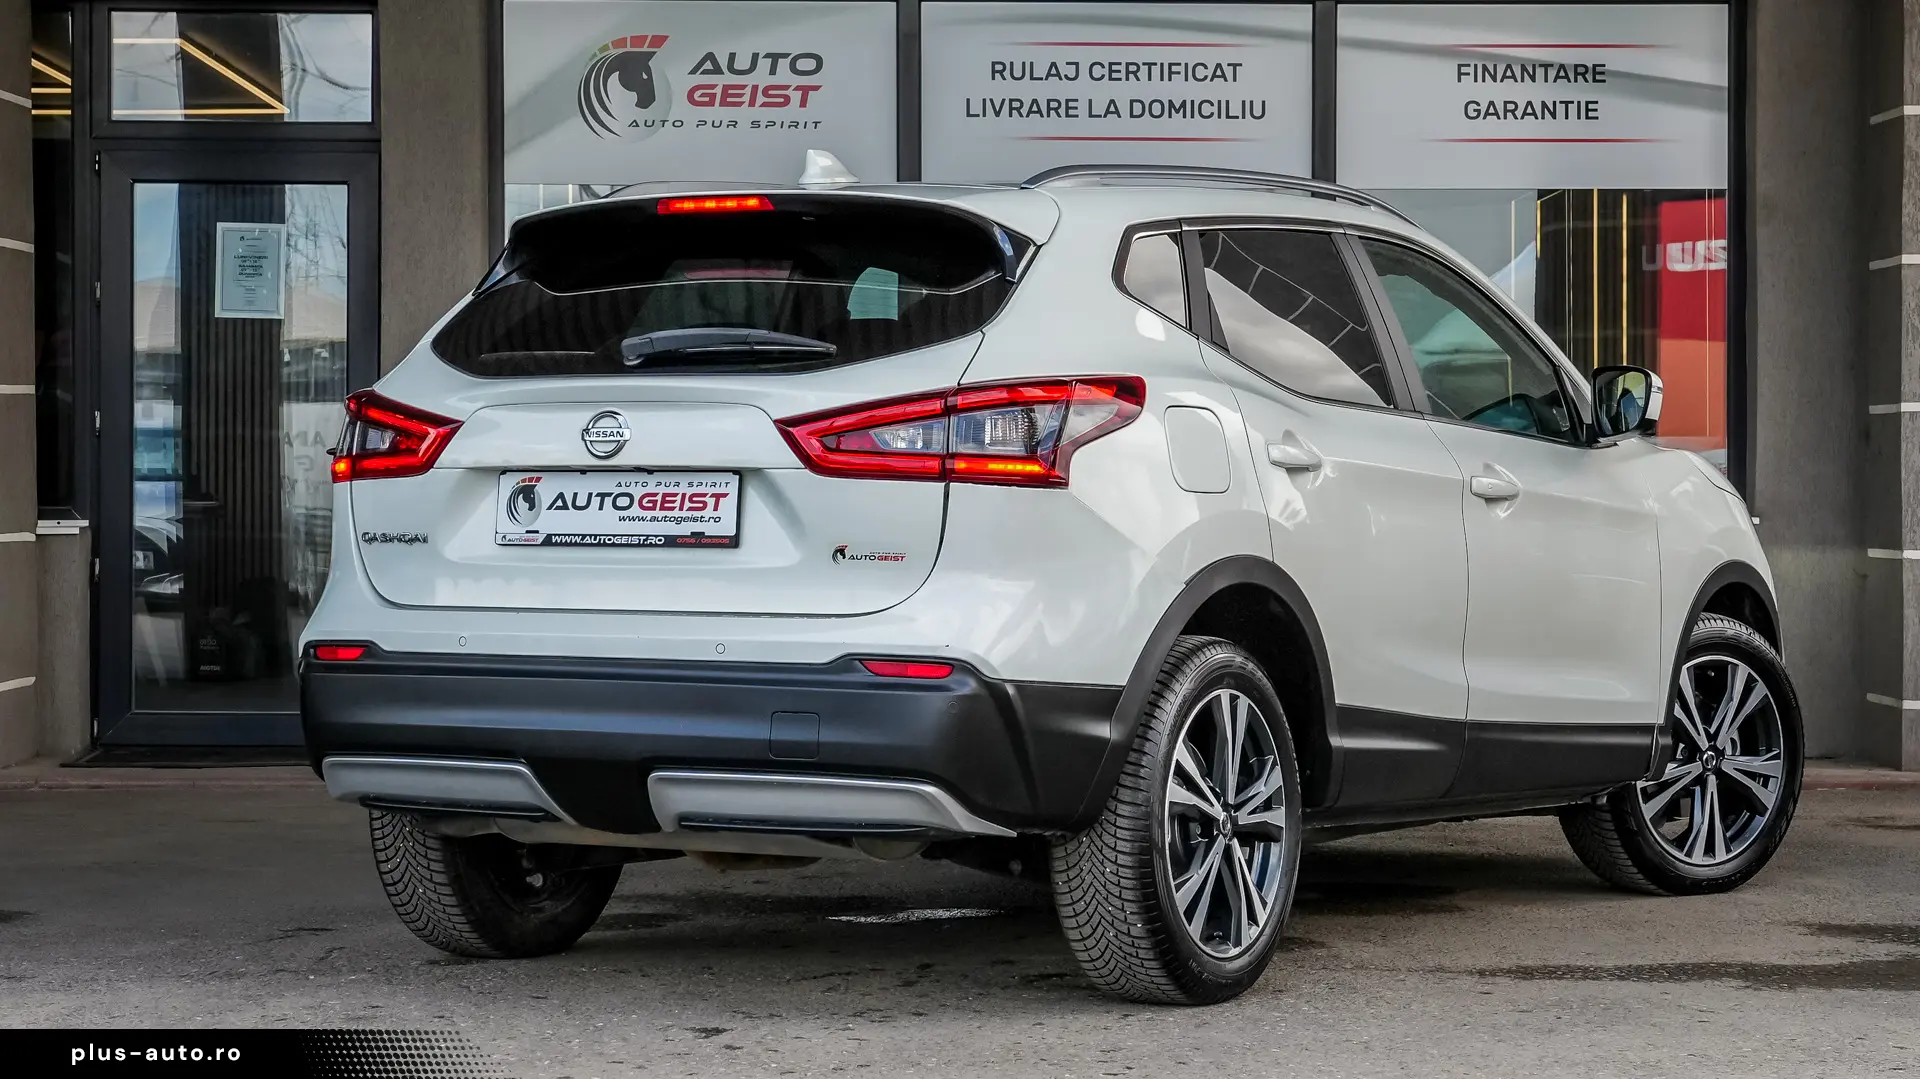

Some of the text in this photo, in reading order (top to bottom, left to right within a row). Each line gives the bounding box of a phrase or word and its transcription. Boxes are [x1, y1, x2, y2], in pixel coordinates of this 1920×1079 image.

[687, 51, 824, 77] AUTO
[990, 60, 1243, 83] RULAJ CERTIFICAT
[1456, 63, 1607, 84] FINANTARE
[686, 83, 824, 109] GEIST
[965, 97, 1267, 120] LIVRARE LA DOMICILIU
[1463, 99, 1600, 121] GARANTIE
[627, 118, 823, 130] AUTO PUR SPIRIT
[585, 430, 625, 438] NISSAN
[686, 481, 731, 489] SPIRIT
[545, 491, 731, 512] AUTOGEIST
[618, 513, 722, 525] www.autogeist.ro
[361, 531, 429, 546] QASHQAI
[551, 535, 665, 545] WWW.AUTOGEIST.RO
[847, 554, 907, 562] AUTOGEIST
